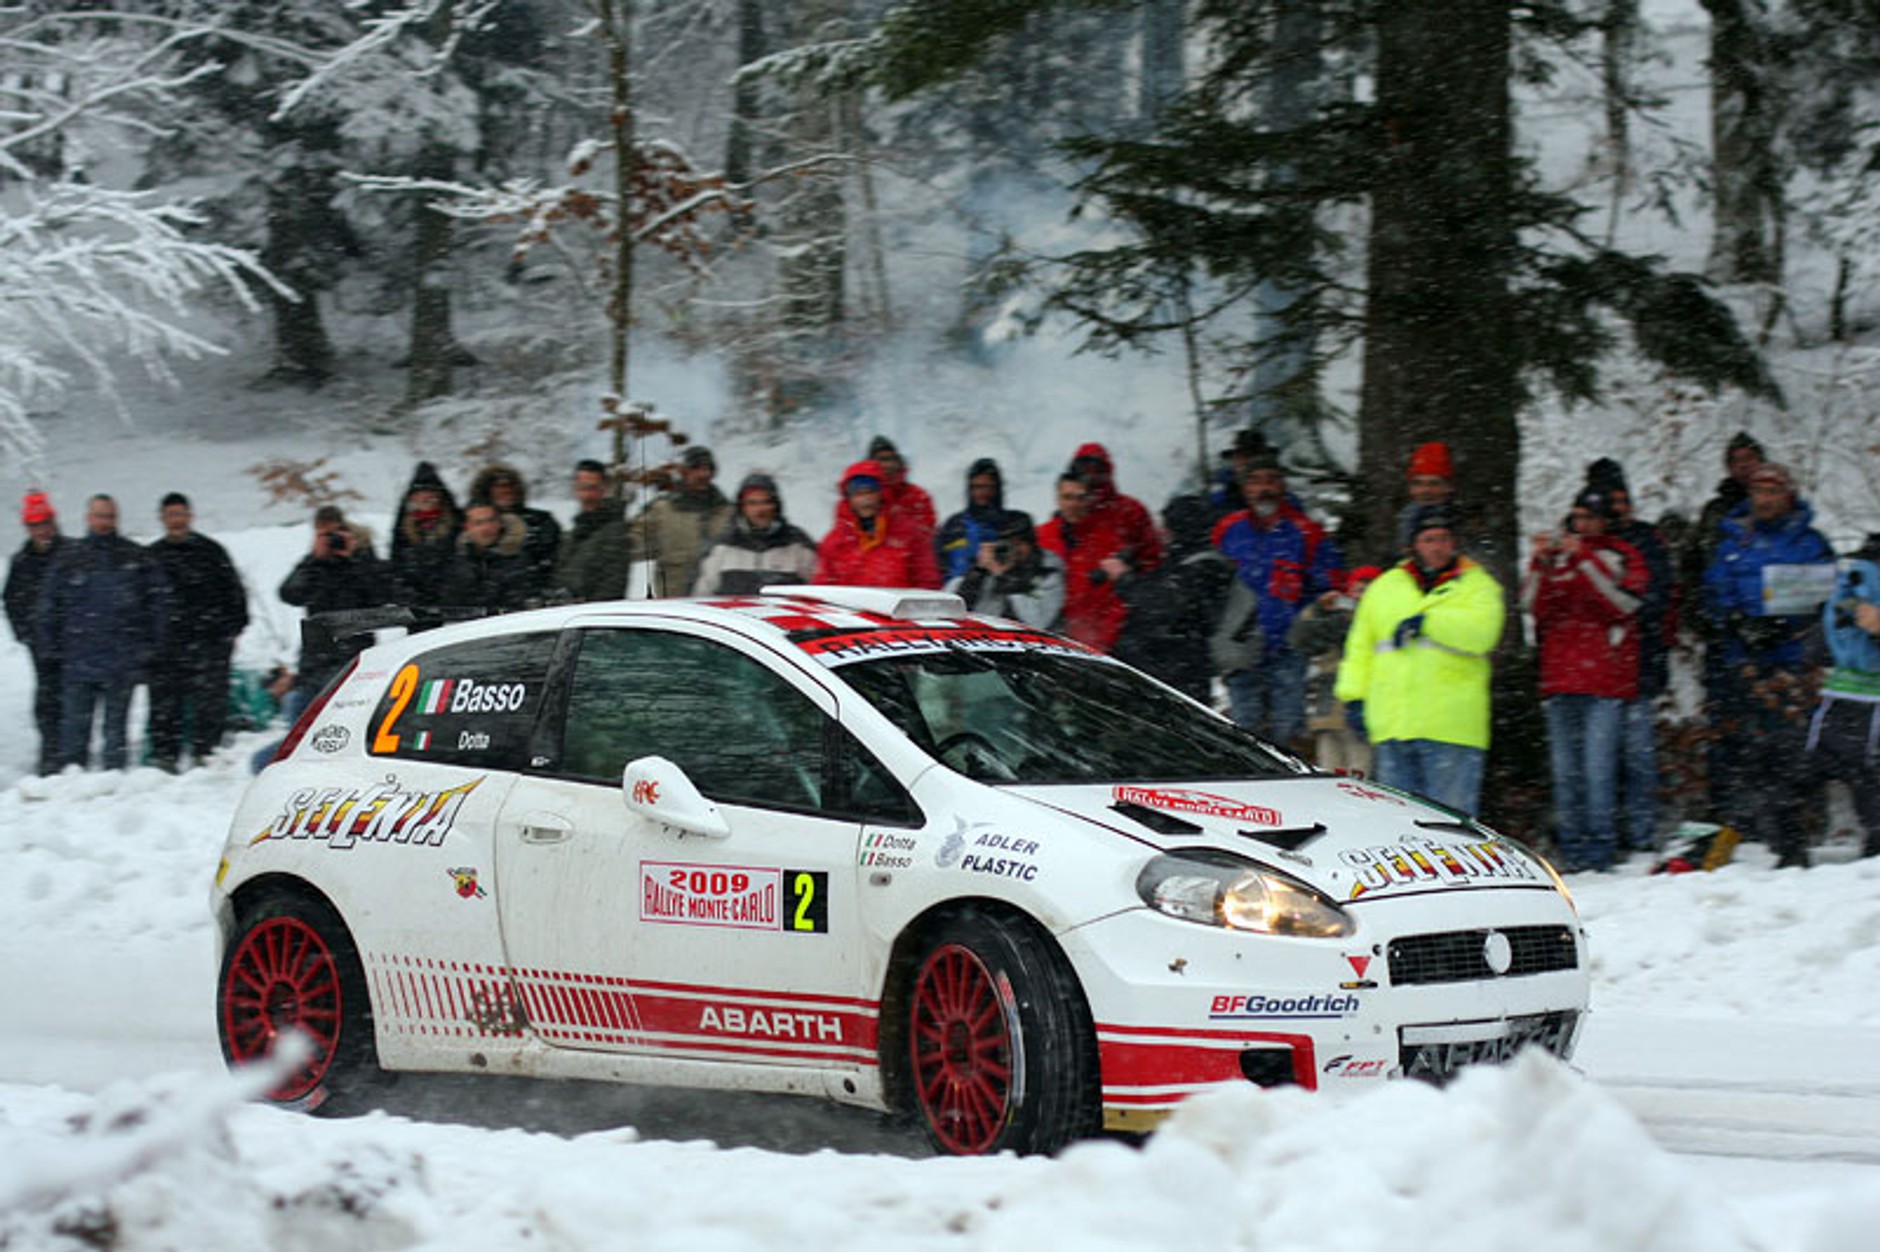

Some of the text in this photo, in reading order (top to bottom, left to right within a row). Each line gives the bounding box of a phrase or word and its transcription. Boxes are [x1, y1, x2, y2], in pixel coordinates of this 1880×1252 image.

[372, 664, 419, 753] 2
[451, 679, 526, 713] Basso
[458, 731, 491, 751] Dotta
[974, 833, 1039, 855] ADLER
[875, 852, 912, 868] Basso
[961, 855, 1038, 881] PLASTIC
[644, 874, 685, 917] RALLYE
[669, 869, 749, 896] 2009
[793, 872, 815, 931] 2
[699, 1006, 843, 1041] ABARTH
